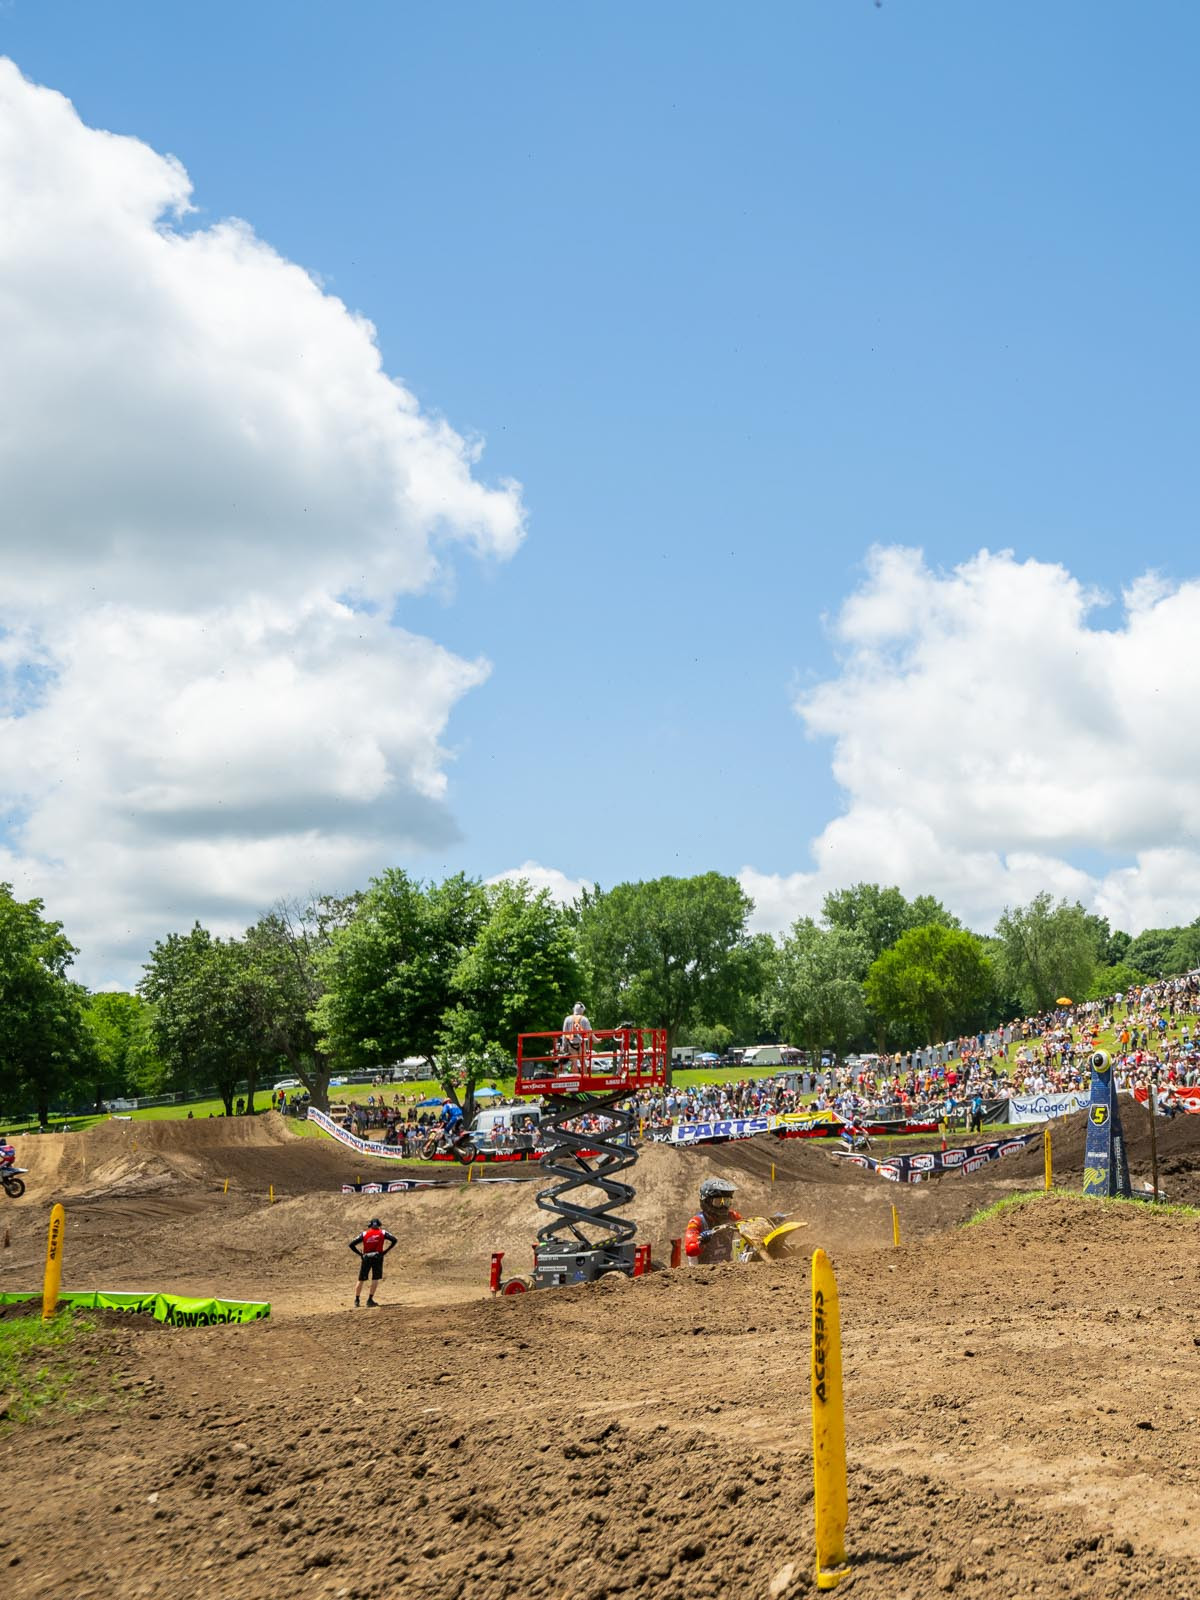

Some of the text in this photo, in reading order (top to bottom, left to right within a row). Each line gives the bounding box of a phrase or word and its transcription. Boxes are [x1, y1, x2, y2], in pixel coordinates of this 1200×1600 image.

[1031, 1097, 1070, 1118] Kroger
[1093, 1107, 1106, 1123] 5
[678, 1118, 768, 1139] PARTS
[944, 1153, 965, 1164] 100%
[964, 1156, 987, 1173] 100%
[49, 1218, 61, 1261] ACERBIS
[165, 1303, 243, 1327] Kawasaki
[815, 1290, 827, 1403] ACERBIS
